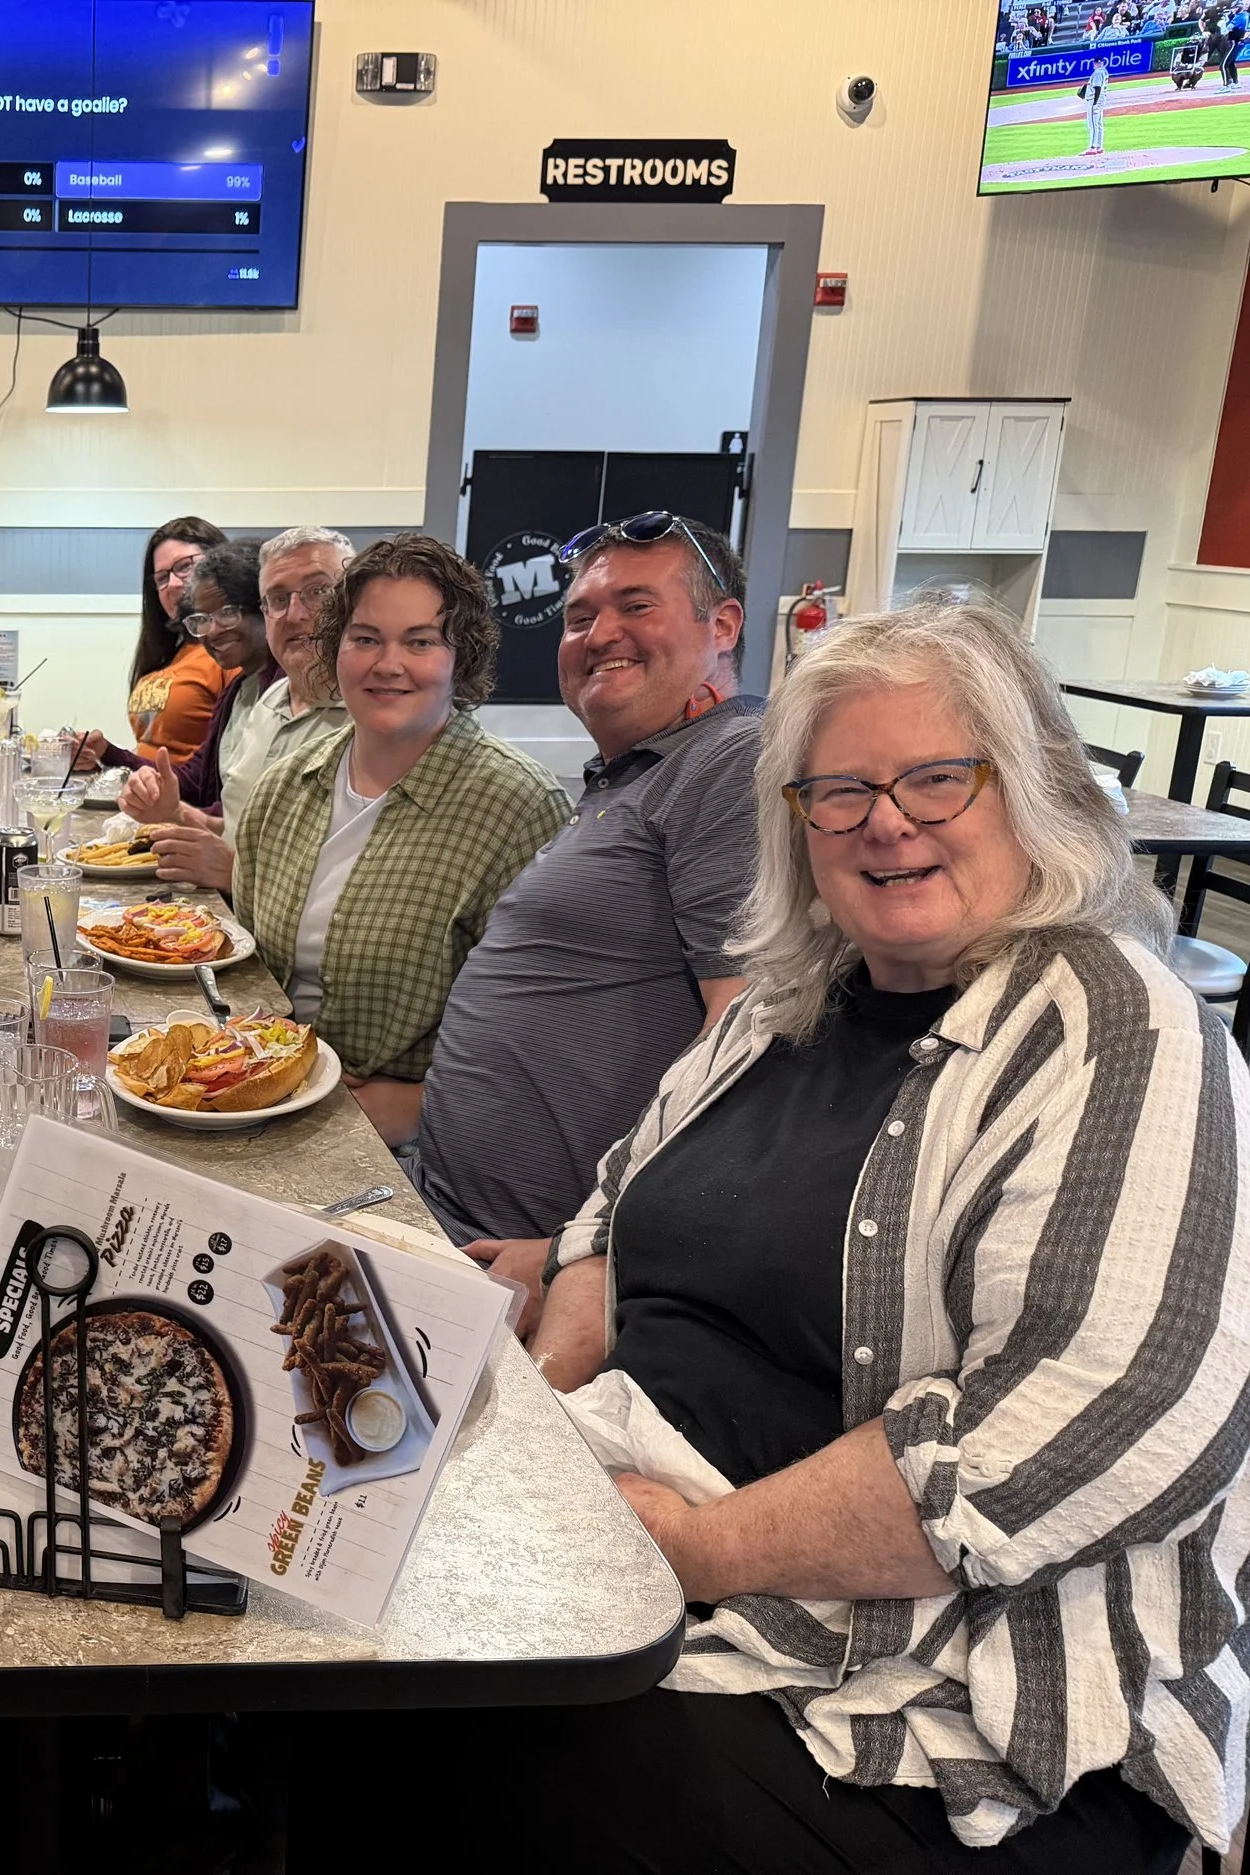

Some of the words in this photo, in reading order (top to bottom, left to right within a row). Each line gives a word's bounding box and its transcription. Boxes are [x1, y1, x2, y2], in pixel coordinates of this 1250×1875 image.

[1017, 59, 1076, 80] xfinity
[1080, 50, 1142, 71] mobile
[15, 95, 54, 112] have
[57, 99, 68, 112] a
[71, 96, 128, 117] goalie?
[24, 172, 42, 186] 0%
[70, 174, 122, 186] Baseball
[546, 158, 729, 186] RESTROOMS
[226, 176, 250, 188] 99%
[23, 208, 41, 222] 0%
[68, 209, 123, 223] Lacrosse
[235, 212, 250, 226] 1%
[522, 535, 551, 549] Good
[496, 554, 560, 606] M
[514, 611, 544, 625] Good
[98, 1205, 115, 1246] Mushroom
[109, 1172, 127, 1205] Marsala
[100, 1205, 135, 1267] Pizza
[195, 1284, 208, 1300] $22
[12, 1341, 23, 1360] Good
[18, 1322, 32, 1340] Food,
[26, 1302, 37, 1319] Good
[355, 1495, 367, 1508] $11
[270, 1517, 305, 1576] GREEN
[292, 1457, 326, 1516] BEANS
[310, 1547, 321, 1565] breaded
[319, 1529, 328, 1541] fried
[325, 1516, 333, 1529] green
